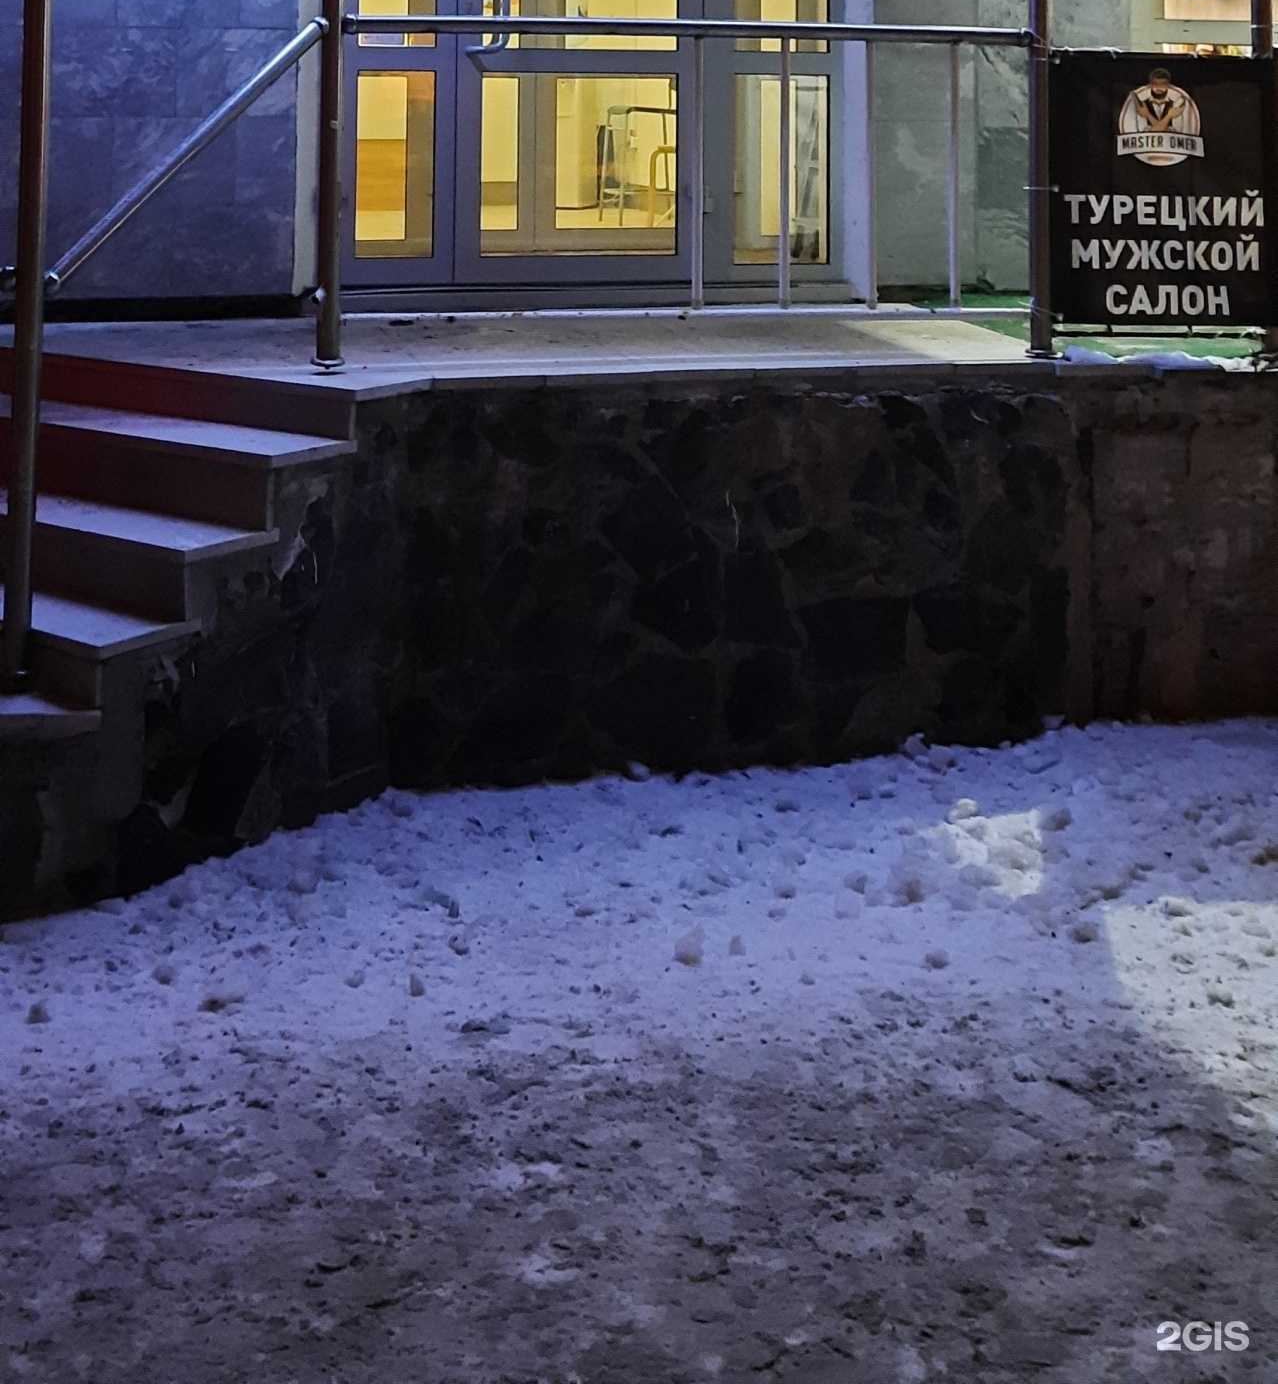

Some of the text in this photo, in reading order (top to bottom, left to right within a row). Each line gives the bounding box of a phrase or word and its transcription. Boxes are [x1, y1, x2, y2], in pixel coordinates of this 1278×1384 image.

[1121, 132, 1198, 151] MASTER OMER
[1063, 189, 1265, 231] ТУРЕЦКИЙ
[1071, 234, 1260, 271] МУЖСКОЙ
[1105, 284, 1230, 316] САЛОН
